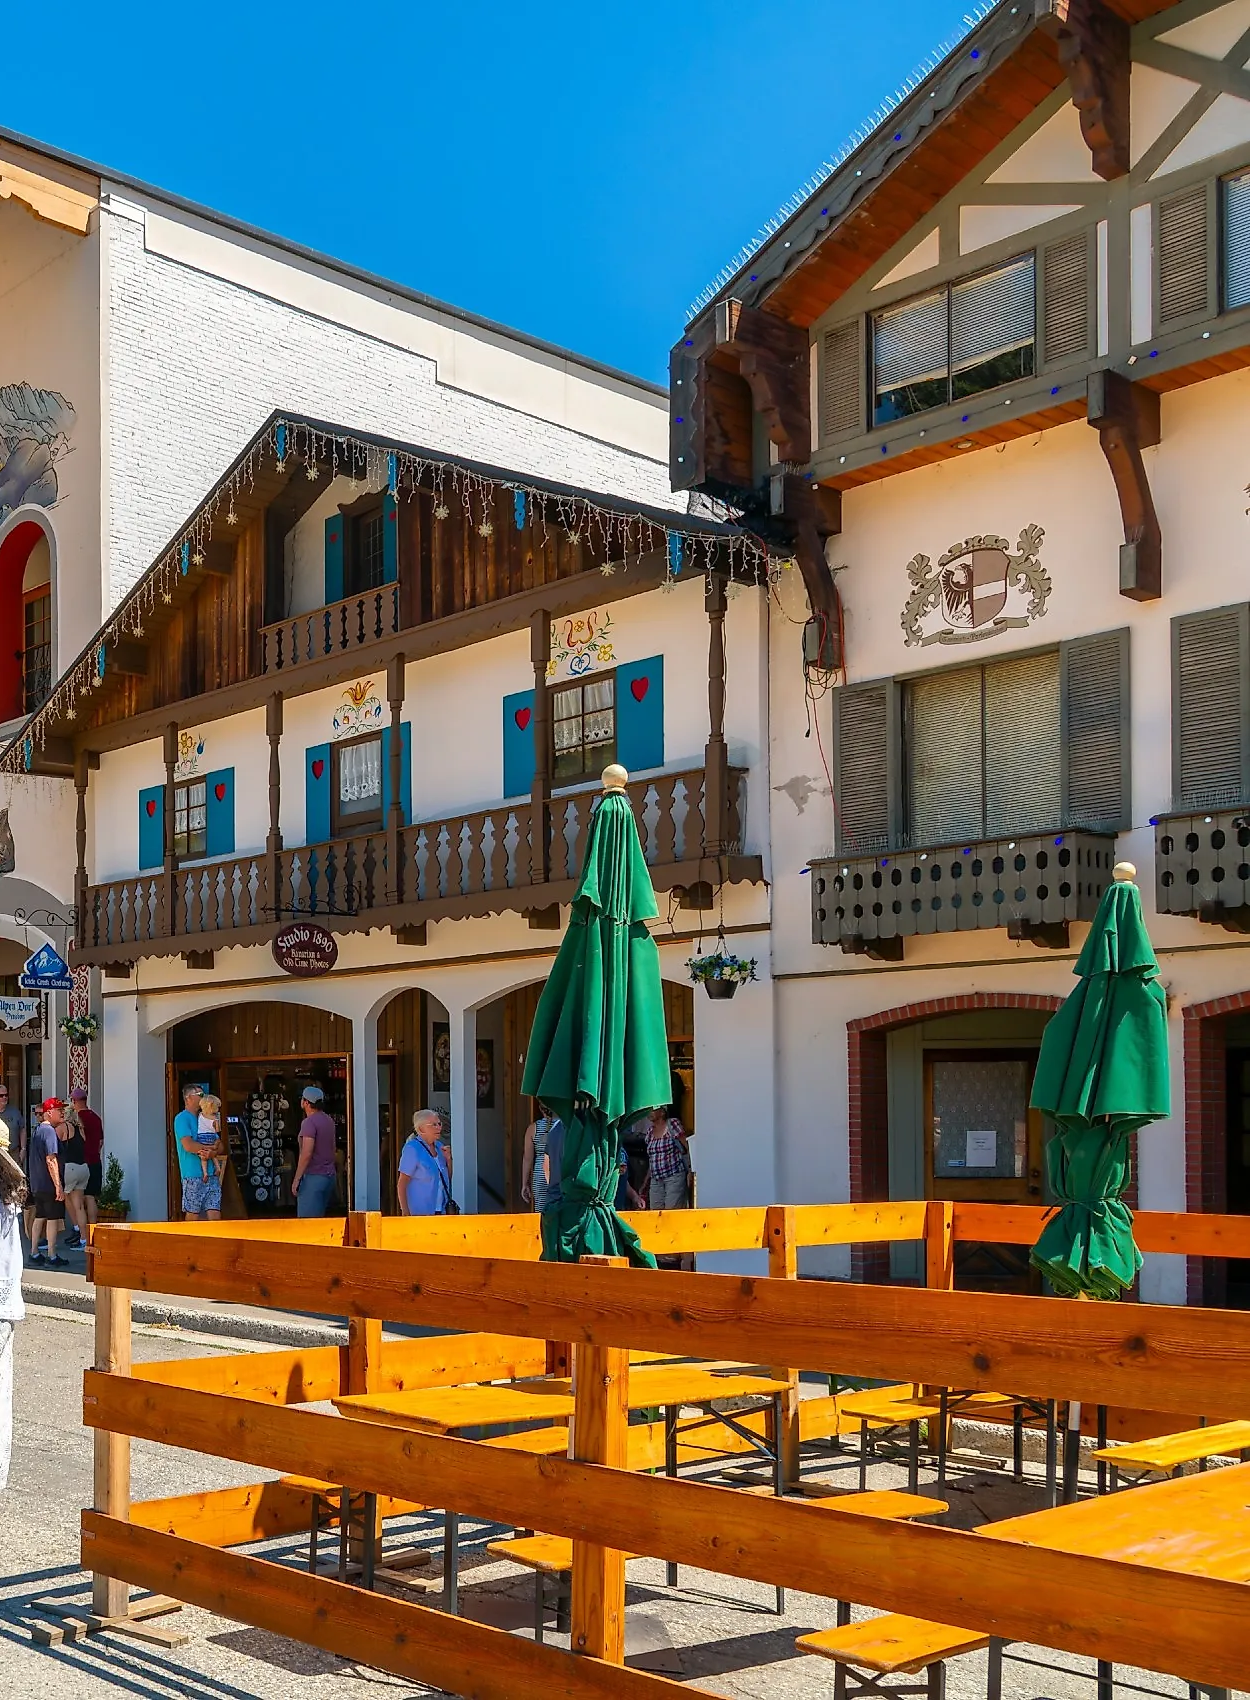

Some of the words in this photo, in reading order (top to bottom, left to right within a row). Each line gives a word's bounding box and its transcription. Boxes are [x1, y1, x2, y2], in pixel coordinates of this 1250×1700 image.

[277, 926, 310, 952] Studio
[312, 930, 333, 952] 1890
[282, 957, 294, 967] Old
[294, 958, 309, 968] Time
[310, 959, 330, 970] Photos
[17, 1001, 35, 1011] Dorf
